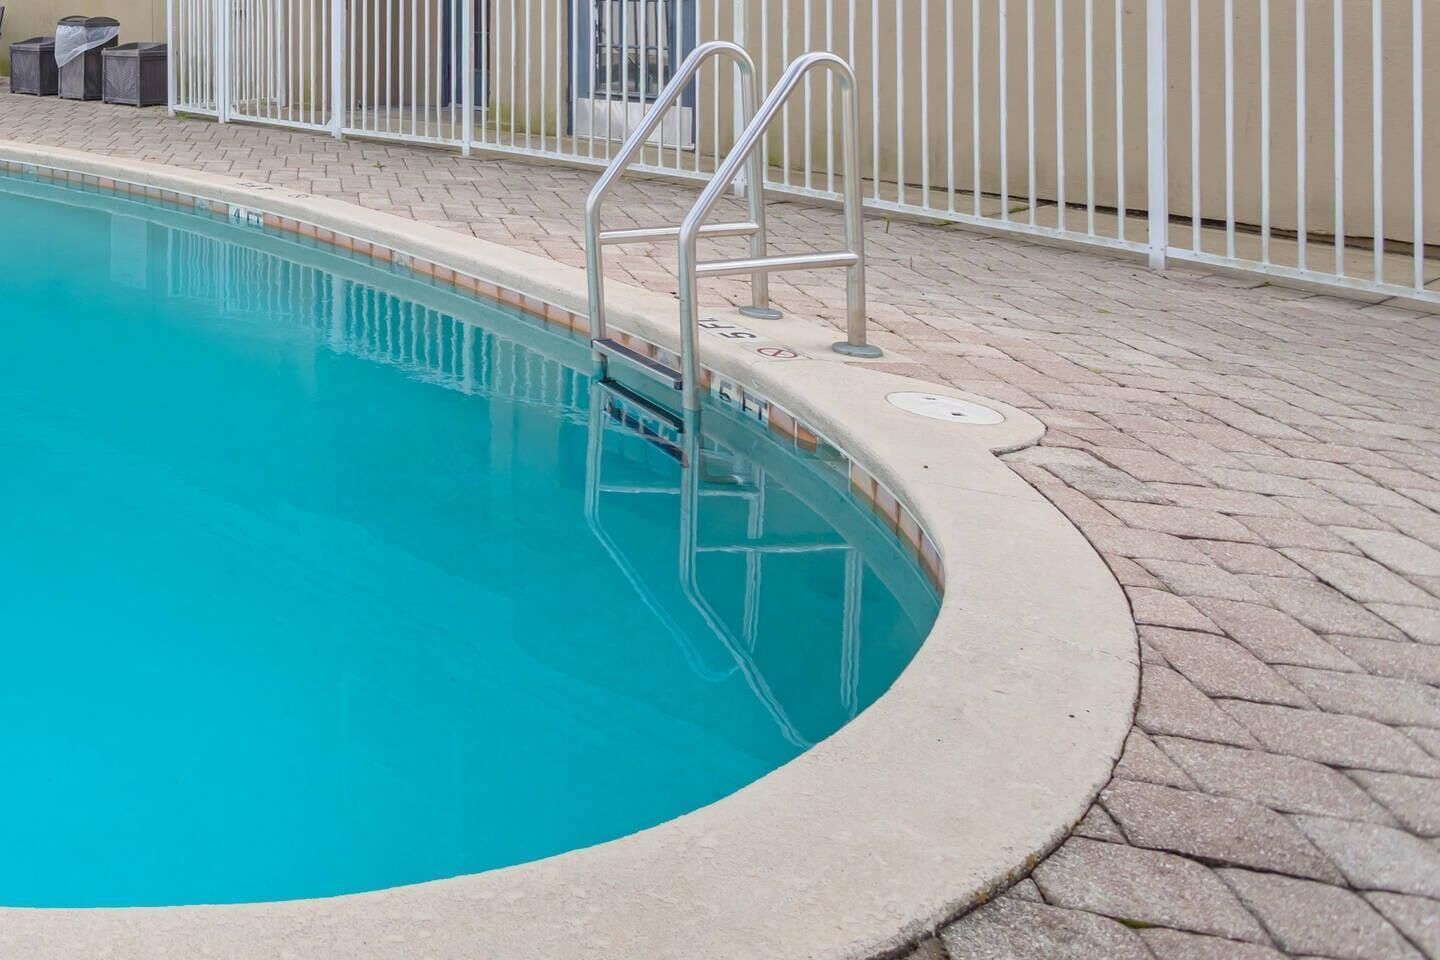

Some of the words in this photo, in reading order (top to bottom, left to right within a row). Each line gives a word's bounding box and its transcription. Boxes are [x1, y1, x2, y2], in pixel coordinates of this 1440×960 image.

[234, 208, 240, 221] 4
[247, 210, 262, 225] FT
[718, 331, 757, 339] 5
[719, 380, 731, 403] 5
